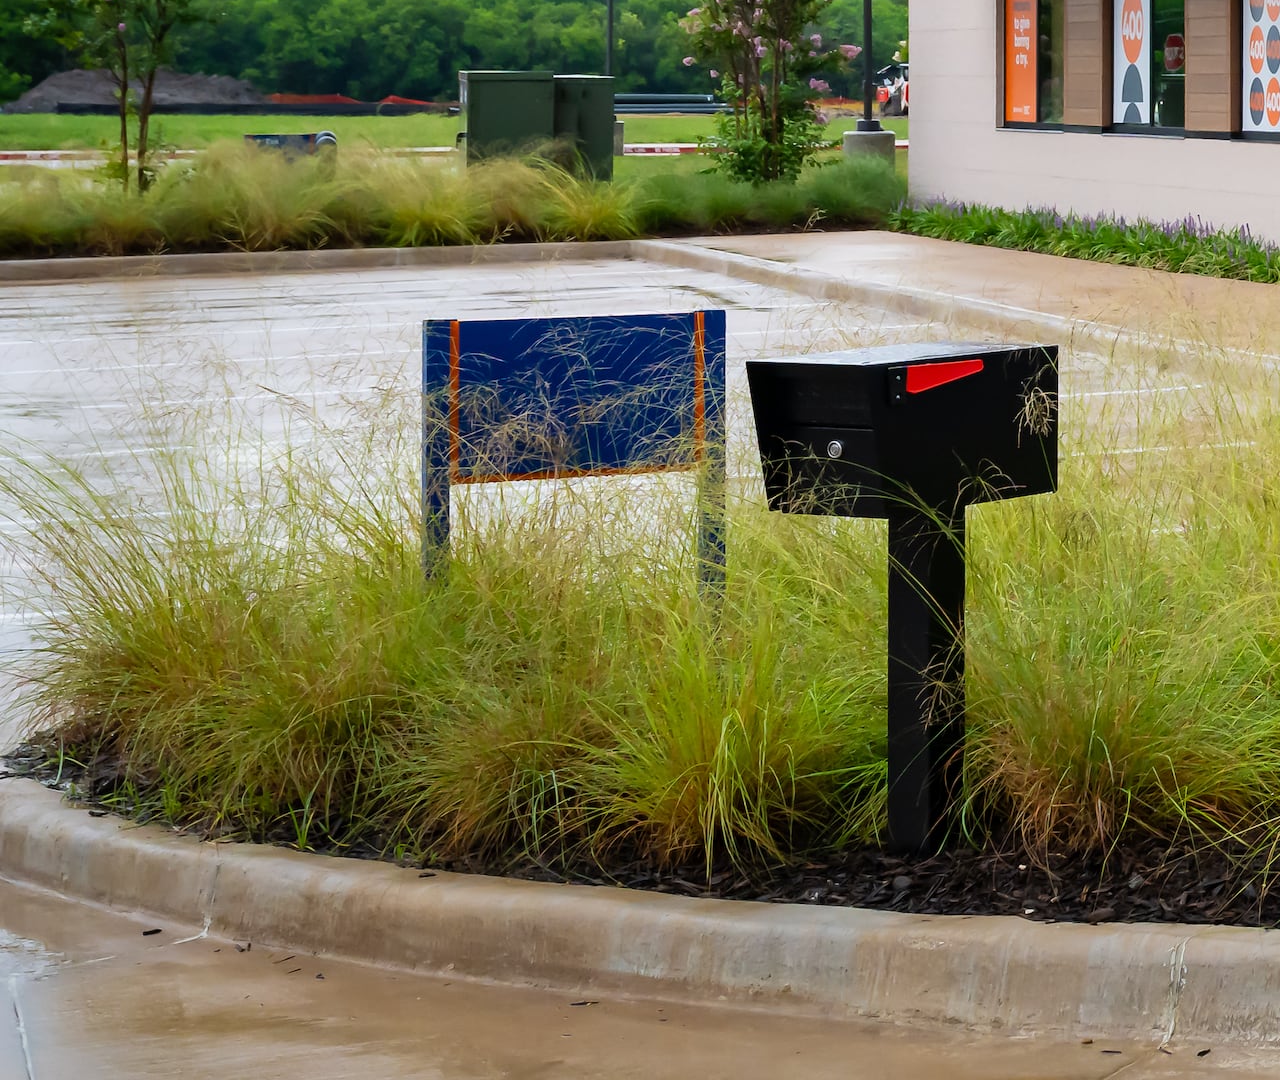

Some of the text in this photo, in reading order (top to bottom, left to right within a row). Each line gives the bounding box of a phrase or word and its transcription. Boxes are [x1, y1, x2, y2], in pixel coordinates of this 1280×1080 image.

[1123, 10, 1143, 40] 400
[1250, 40, 1265, 59] 400
[1267, 92, 1280, 111] 400
